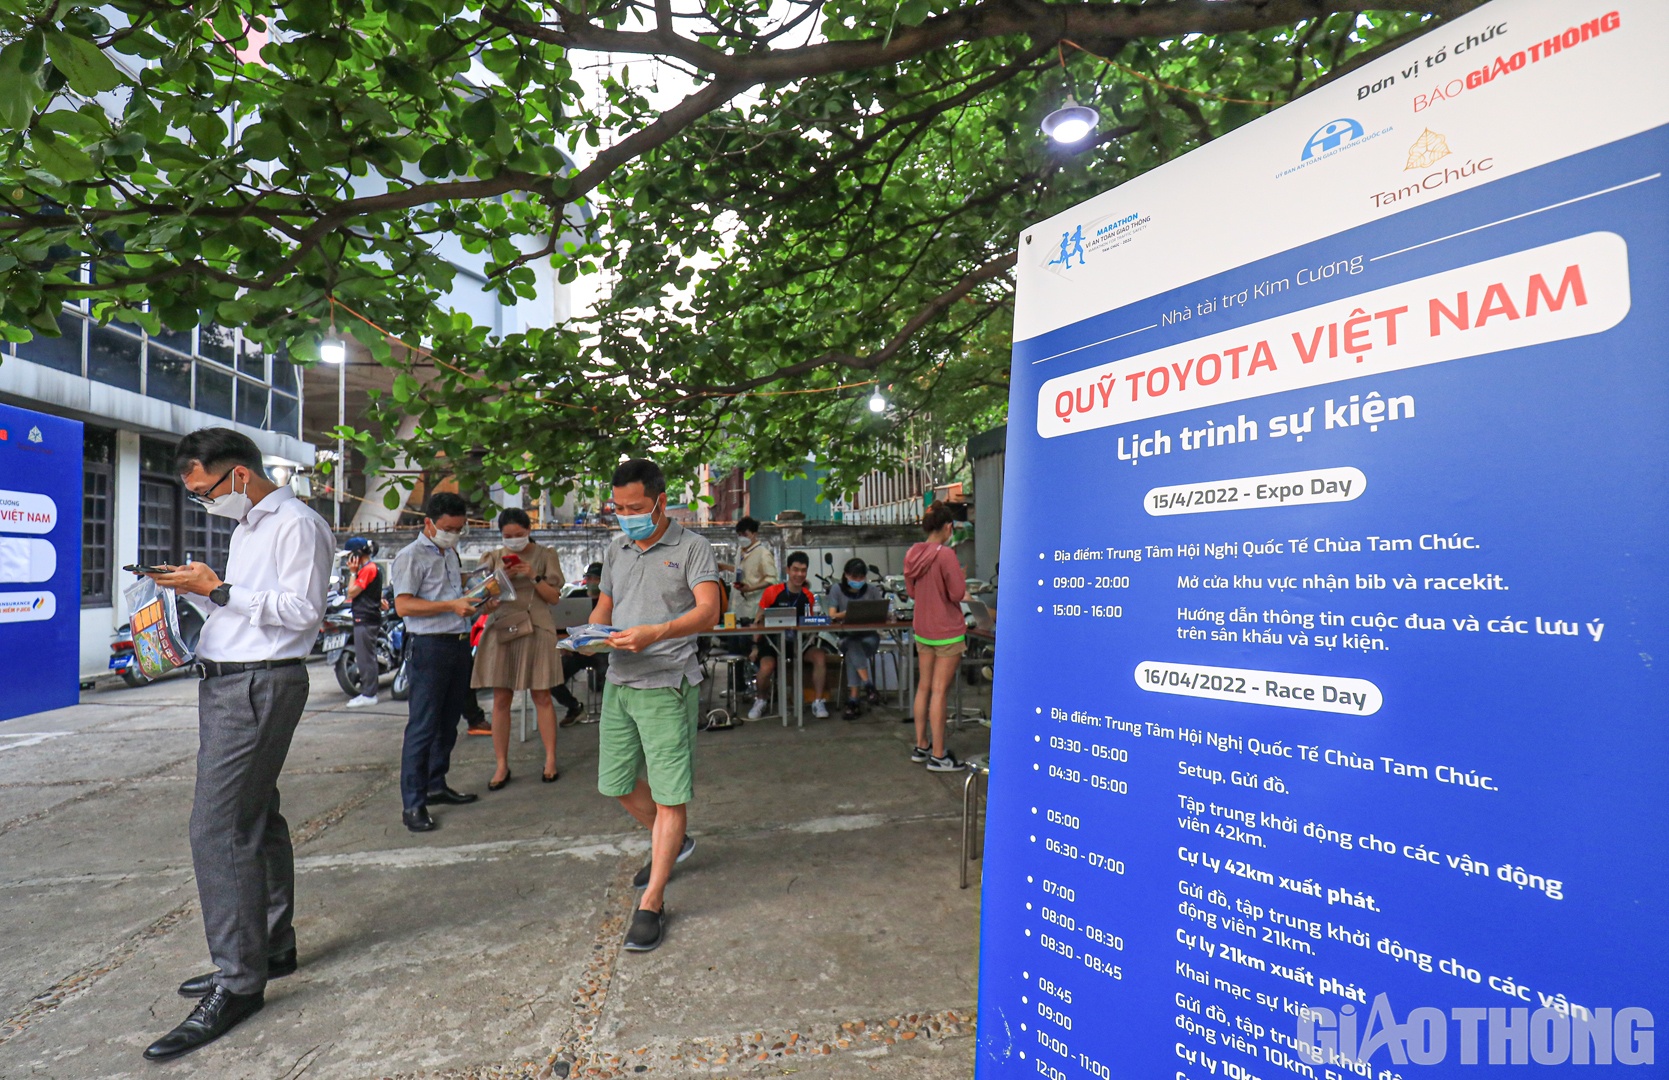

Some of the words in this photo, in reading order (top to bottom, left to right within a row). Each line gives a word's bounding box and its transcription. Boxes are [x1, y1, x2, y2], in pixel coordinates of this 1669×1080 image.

[1357, 75, 1395, 100] Đơn
[1401, 60, 1419, 78] vị
[1425, 45, 1447, 68] tổ
[1454, 21, 1508, 55] chức
[1413, 79, 1464, 113] BÁO
[1284, 166, 1296, 175] BAN
[1322, 149, 1338, 159] GIAO
[1381, 126, 1394, 134] GIA
[1096, 212, 1138, 236] MARATHON
[1091, 238, 1100, 246] AN
[1161, 306, 1192, 327] Nhà
[1197, 297, 1217, 316] tài
[1222, 288, 1249, 307] trợ
[1254, 277, 1290, 300] Kim
[1296, 254, 1364, 286] Cương
[1055, 373, 1116, 423] QUỸ
[1125, 340, 1277, 402] TOYOTA
[1291, 305, 1408, 364] VIỆT
[1428, 264, 1588, 337] NAM
[1117, 429, 1171, 466] Lịch
[1179, 414, 1258, 451] trình
[1268, 406, 1315, 443] sự
[1324, 390, 1415, 432] kiện
[1153, 487, 1238, 509] 15/4/2022
[1256, 484, 1304, 502] Expo
[1310, 478, 1352, 497] Day
[27, 511, 51, 523] NAM
[1054, 550, 1070, 563] Địa
[1074, 548, 1103, 560] điểm:
[1106, 548, 1141, 561] Trung
[1145, 545, 1173, 557] Tâm
[1178, 544, 1199, 559] Hội
[1205, 542, 1237, 559] Nghị
[1243, 539, 1283, 557] Quốc
[1288, 537, 1308, 553] Tế
[1314, 537, 1361, 552] Chùa
[1367, 537, 1412, 551] Tam
[1420, 533, 1479, 550] Chúc.
[1054, 577, 1084, 588] 09:00
[1095, 577, 1129, 588] 20:00
[1178, 575, 1199, 588] Mở
[1203, 575, 1228, 588] cửa
[1234, 575, 1262, 588] khu
[1267, 576, 1297, 592] vực
[1303, 574, 1349, 592] nhận
[1356, 574, 1386, 589] bib
[1392, 574, 1416, 589] và
[1425, 574, 1508, 590] racekit.
[1053, 605, 1080, 616] 15:00
[1092, 606, 1122, 617] 16:00
[1178, 608, 1224, 625] Hướng
[1229, 607, 1257, 622] dẫn
[1263, 609, 1314, 629] thông
[1319, 611, 1344, 626] tin
[1351, 612, 1398, 631] cuộc
[1405, 613, 1445, 630] đua
[1452, 615, 1479, 631] và
[1487, 616, 1528, 633] các
[1536, 617, 1578, 635] lưu
[1586, 618, 1604, 641] ý
[1177, 626, 1206, 640] trên
[1211, 628, 1237, 641] sân
[1243, 629, 1282, 644] khấu
[1288, 631, 1308, 645] và
[1314, 635, 1337, 651] sự
[1343, 633, 1389, 653] kiện.
[1144, 668, 1246, 694] 16/04/2022
[1265, 680, 1315, 701] Race
[1322, 685, 1367, 711] Day
[1050, 736, 1080, 752] 03:30
[1092, 745, 1127, 762] 05:00
[1051, 708, 1067, 721] Địa
[1071, 711, 1101, 726] điểm:
[1105, 716, 1141, 737] Trung
[1145, 722, 1174, 739] Tâm
[1179, 728, 1201, 746] Hội
[1207, 732, 1242, 754] Nghị
[1248, 739, 1292, 757] Quốc
[1297, 745, 1318, 761] Tế
[1325, 750, 1374, 770] Chùa
[1380, 757, 1427, 779] Tam
[1436, 766, 1498, 791] Chúc.
[1049, 765, 1080, 782] 04:30
[1091, 775, 1127, 794] 05:00
[1179, 761, 1225, 784] Setup,
[1231, 771, 1257, 788] Gửi
[1264, 776, 1288, 794] đồ.
[1047, 810, 1079, 829] 05:00
[1178, 816, 1209, 834] viên
[1215, 824, 1266, 848] 42km.
[1046, 838, 1077, 859] 06:30
[1089, 852, 1124, 874] 07:00
[1178, 795, 1205, 815] Tập
[1210, 803, 1255, 828] trung
[1261, 812, 1297, 833] khởi
[1304, 822, 1352, 849] động
[1359, 834, 1396, 854] cho
[1403, 845, 1440, 864] các
[1446, 854, 1489, 876] vận
[1497, 864, 1563, 900] động
[1043, 880, 1074, 902] 07:00
[1178, 847, 1198, 866] Cự
[1203, 852, 1220, 873] Ly
[1225, 859, 1273, 885] 42km
[1279, 876, 1321, 897] xuất
[1328, 888, 1380, 912] phát.
[1042, 907, 1074, 931] 08:00
[1086, 926, 1123, 950] 08:30
[1179, 901, 1217, 929] động
[1222, 915, 1256, 938] viên
[1263, 927, 1315, 955] 21km.
[1041, 934, 1073, 958] 08:30
[1085, 954, 1121, 980] 08:45
[1177, 929, 1196, 950] Cự
[1200, 936, 1215, 957] ly
[1220, 944, 1265, 971] 21km
[1271, 963, 1313, 986] xuất
[1320, 978, 1366, 1004] phát
[1179, 880, 1202, 899] Gửi
[1208, 890, 1230, 910] đồ,
[1236, 899, 1263, 923] tập
[1268, 908, 1322, 940] trung
[1328, 922, 1370, 948] khởi
[1377, 938, 1432, 972] động
[1439, 958, 1481, 983] cho
[1489, 976, 1530, 1001] các
[1537, 990, 1588, 1022] vận
[1039, 978, 1071, 1003] 08:45
[1176, 960, 1208, 985] Khai
[1215, 978, 1250, 1000] mạc
[1257, 993, 1278, 1011] sự
[1283, 996, 1323, 1026] kiện
[1038, 1003, 1071, 1030] 09:00
[1176, 1015, 1216, 1044] động
[1221, 1033, 1257, 1056] viên
[1176, 993, 1200, 1014] Gửi
[1206, 1005, 1230, 1026] đồ,
[1236, 1016, 1264, 1040] tập
[1269, 1027, 1324, 1065] trung
[1329, 1046, 1373, 1080] khởi
